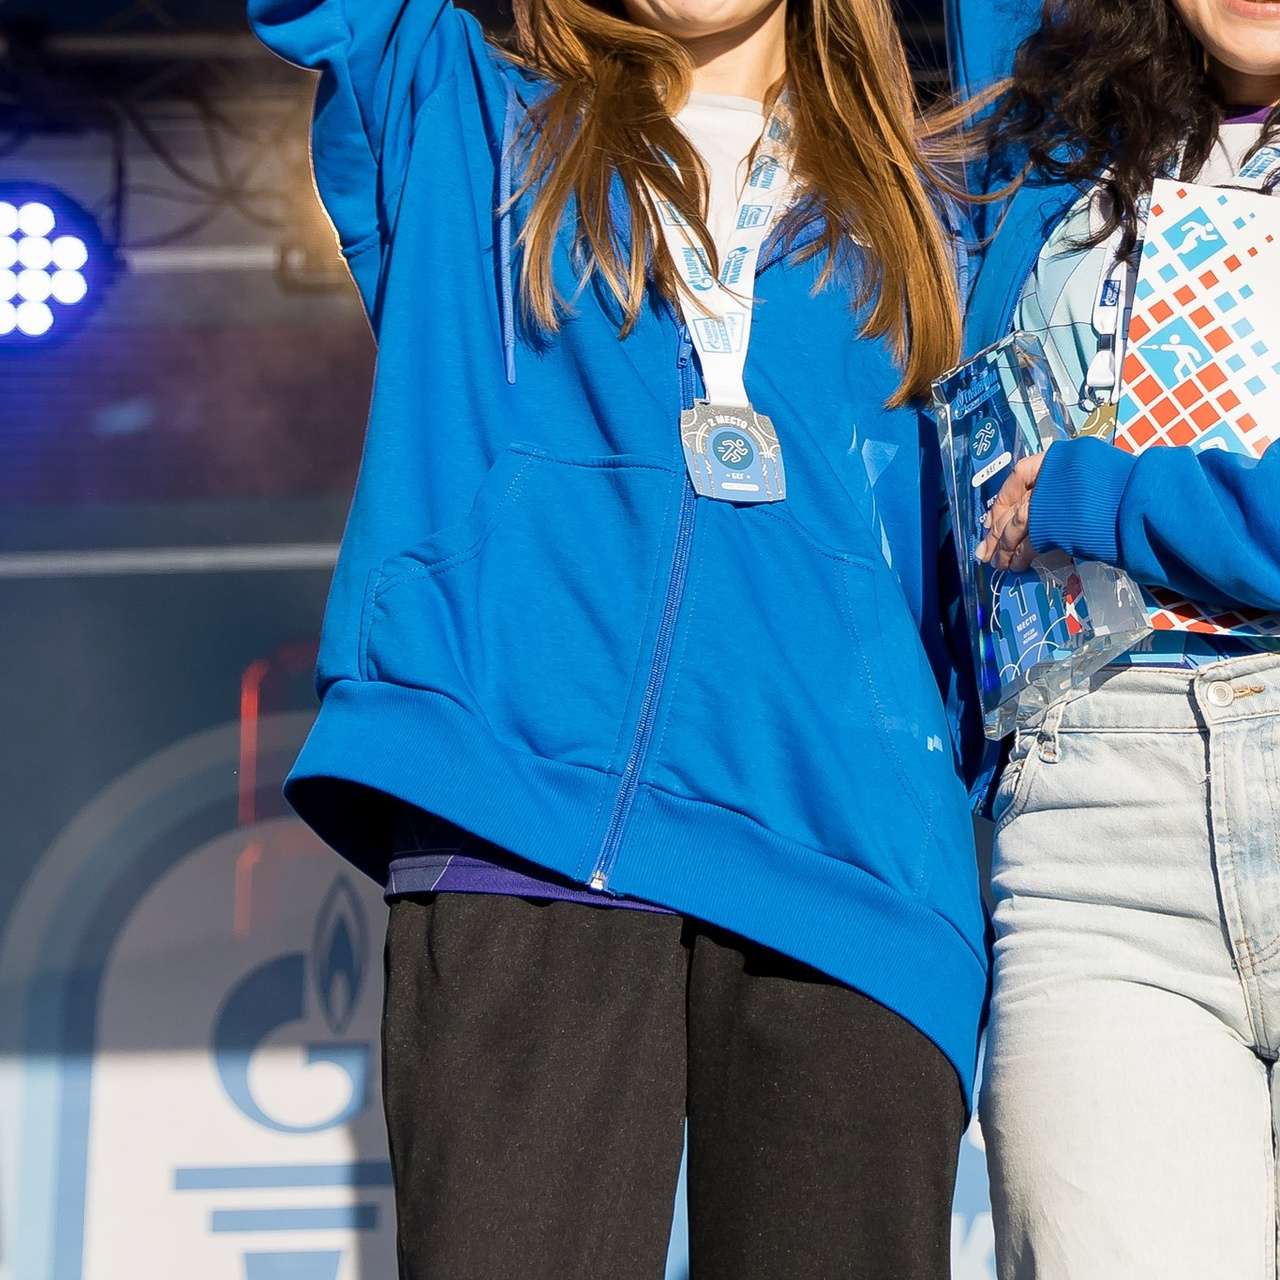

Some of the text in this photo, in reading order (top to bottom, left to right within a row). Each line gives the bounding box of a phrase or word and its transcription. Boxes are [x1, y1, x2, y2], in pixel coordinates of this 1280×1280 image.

[707, 415, 748, 429] 2 МЕСТО
[1008, 577, 1028, 617] 1
[1016, 613, 1037, 633] МЕСТО
